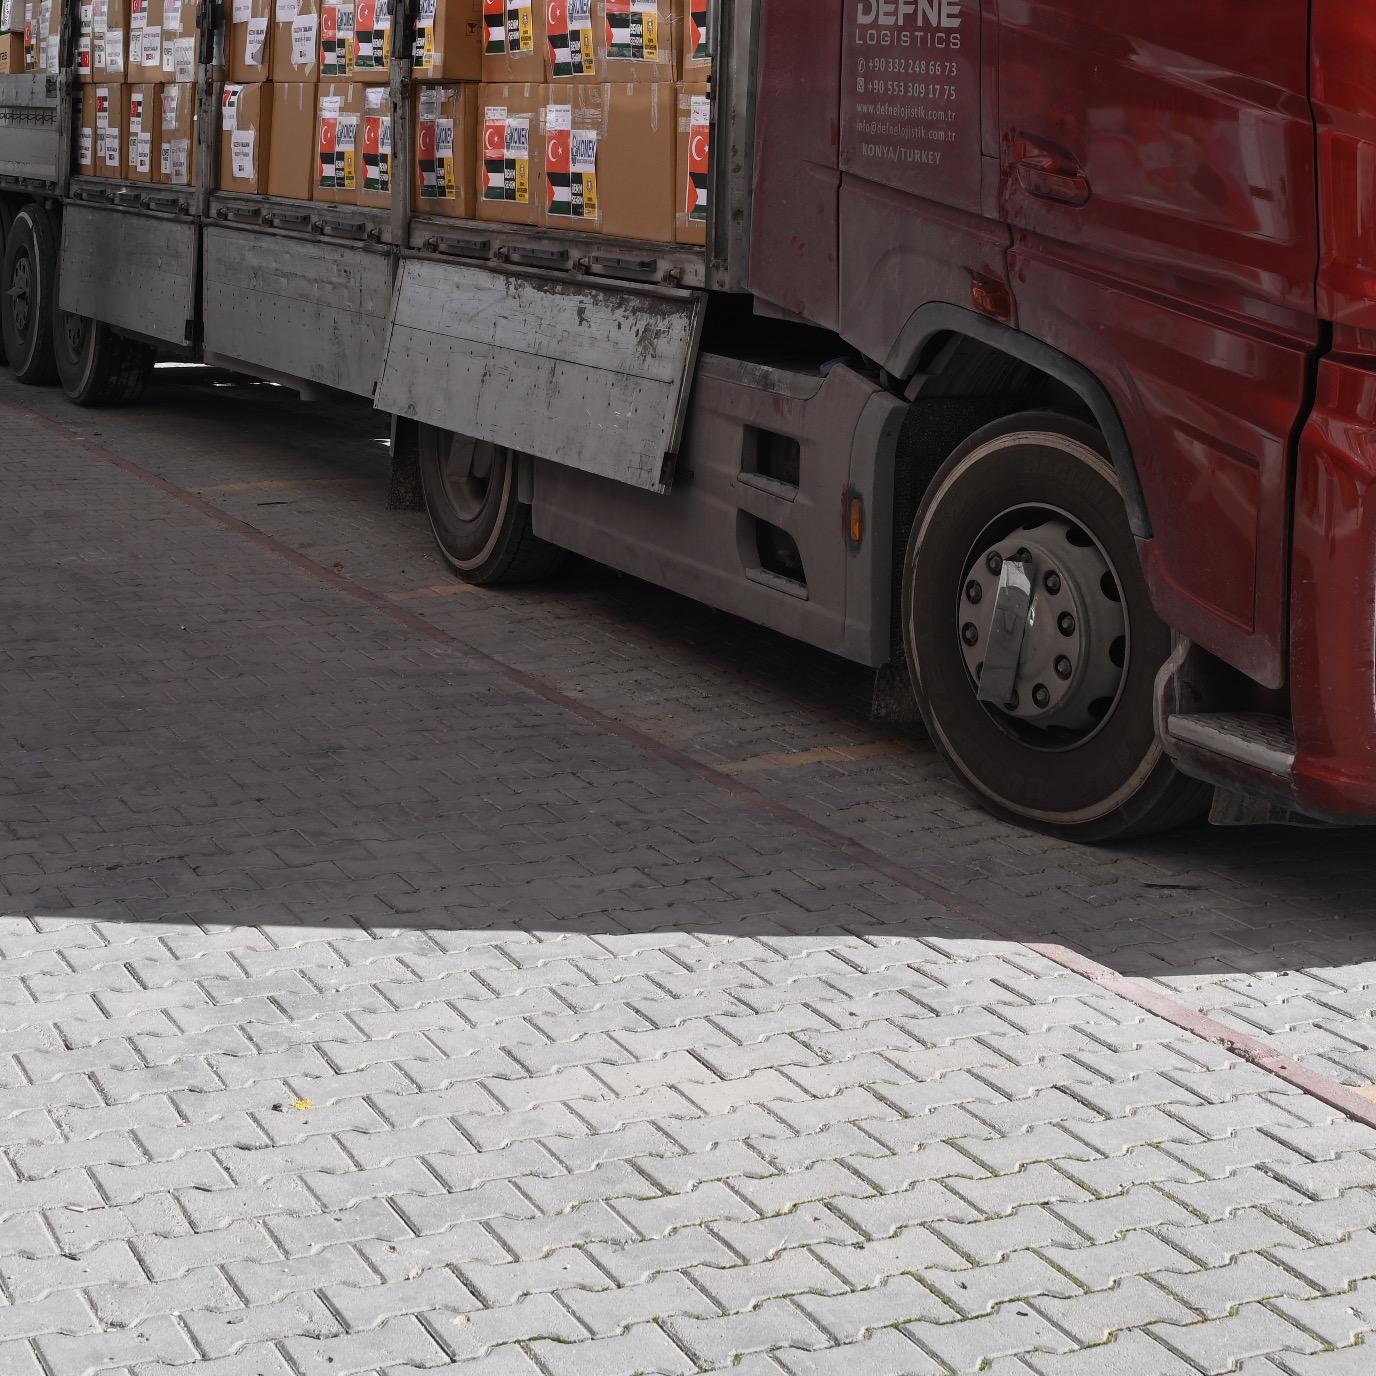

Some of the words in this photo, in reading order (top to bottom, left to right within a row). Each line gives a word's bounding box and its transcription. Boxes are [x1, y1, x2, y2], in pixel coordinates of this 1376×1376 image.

[855, 28, 961, 49] LOGISTICS
[868, 58, 886, 71] +90
[888, 58, 905, 73] 332
[908, 60, 926, 74] 248
[929, 61, 941, 75] 66
[944, 62, 957, 76] 73
[867, 80, 885, 94] +90
[887, 81, 904, 95] 553
[907, 82, 925, 97] 309
[928, 84, 939, 98] 17
[944, 85, 956, 100] 75
[856, 102, 956, 121] www.defnelojistik.com.tr
[856, 121, 956, 142] info@defnelojistik.com.tr
[862, 143, 942, 165] KONYA/TURKEY
